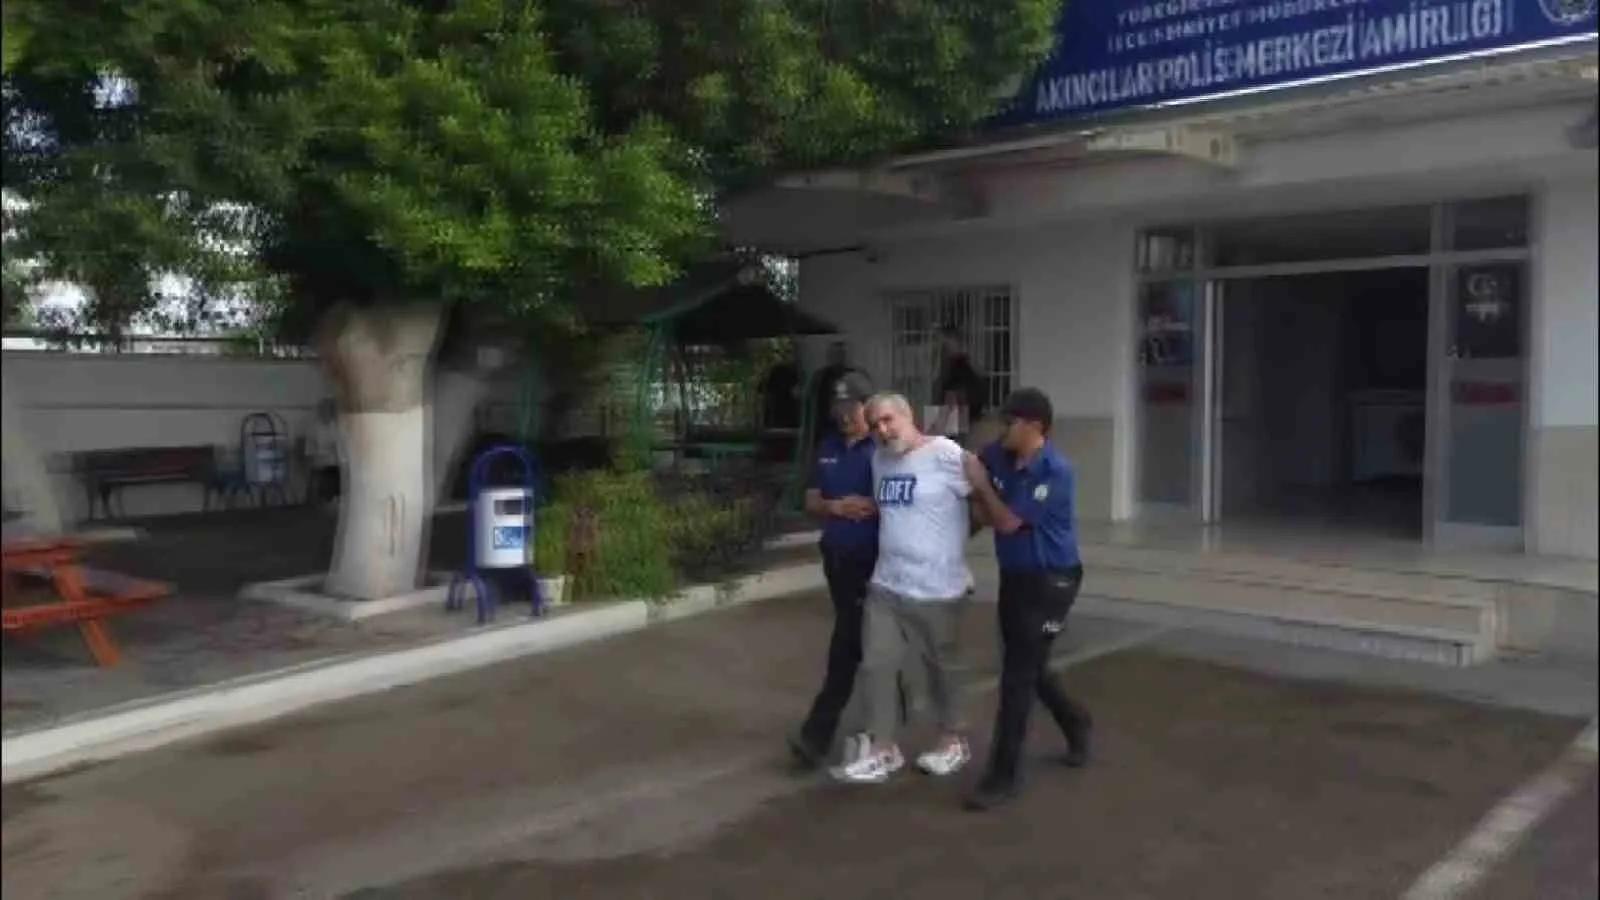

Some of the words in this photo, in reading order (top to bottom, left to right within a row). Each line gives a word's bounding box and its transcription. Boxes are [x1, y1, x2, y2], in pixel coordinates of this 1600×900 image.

[1035, 62, 1153, 113] AKINCILAR
[1158, 40, 1228, 93] POLİS
[1230, 14, 1355, 78] MERKEZİ
